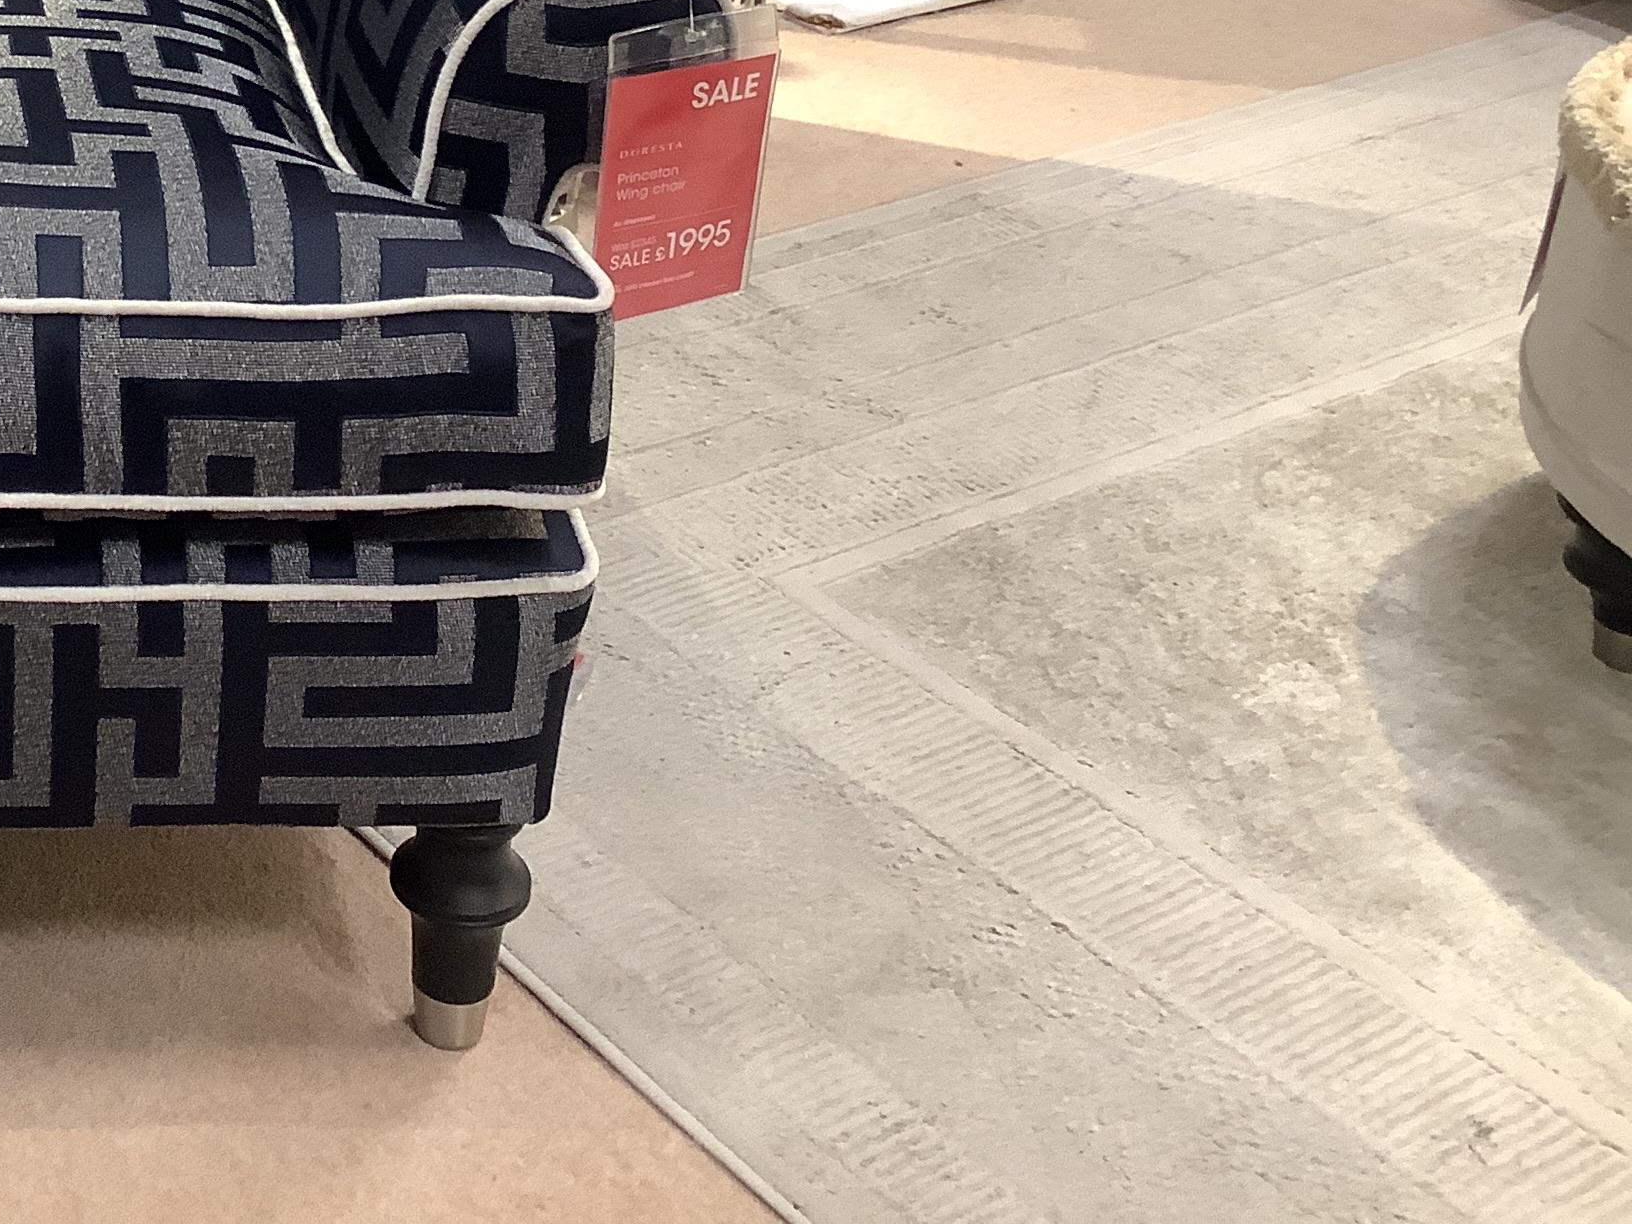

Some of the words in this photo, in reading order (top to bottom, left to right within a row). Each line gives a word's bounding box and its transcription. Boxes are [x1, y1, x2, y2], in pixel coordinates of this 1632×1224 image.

[692, 73, 760, 108] SALE
[615, 186, 650, 202] Wing
[652, 178, 687, 195] chair
[616, 165, 680, 187] Princeton
[609, 249, 651, 271] SALE
[655, 219, 731, 262] £1995
